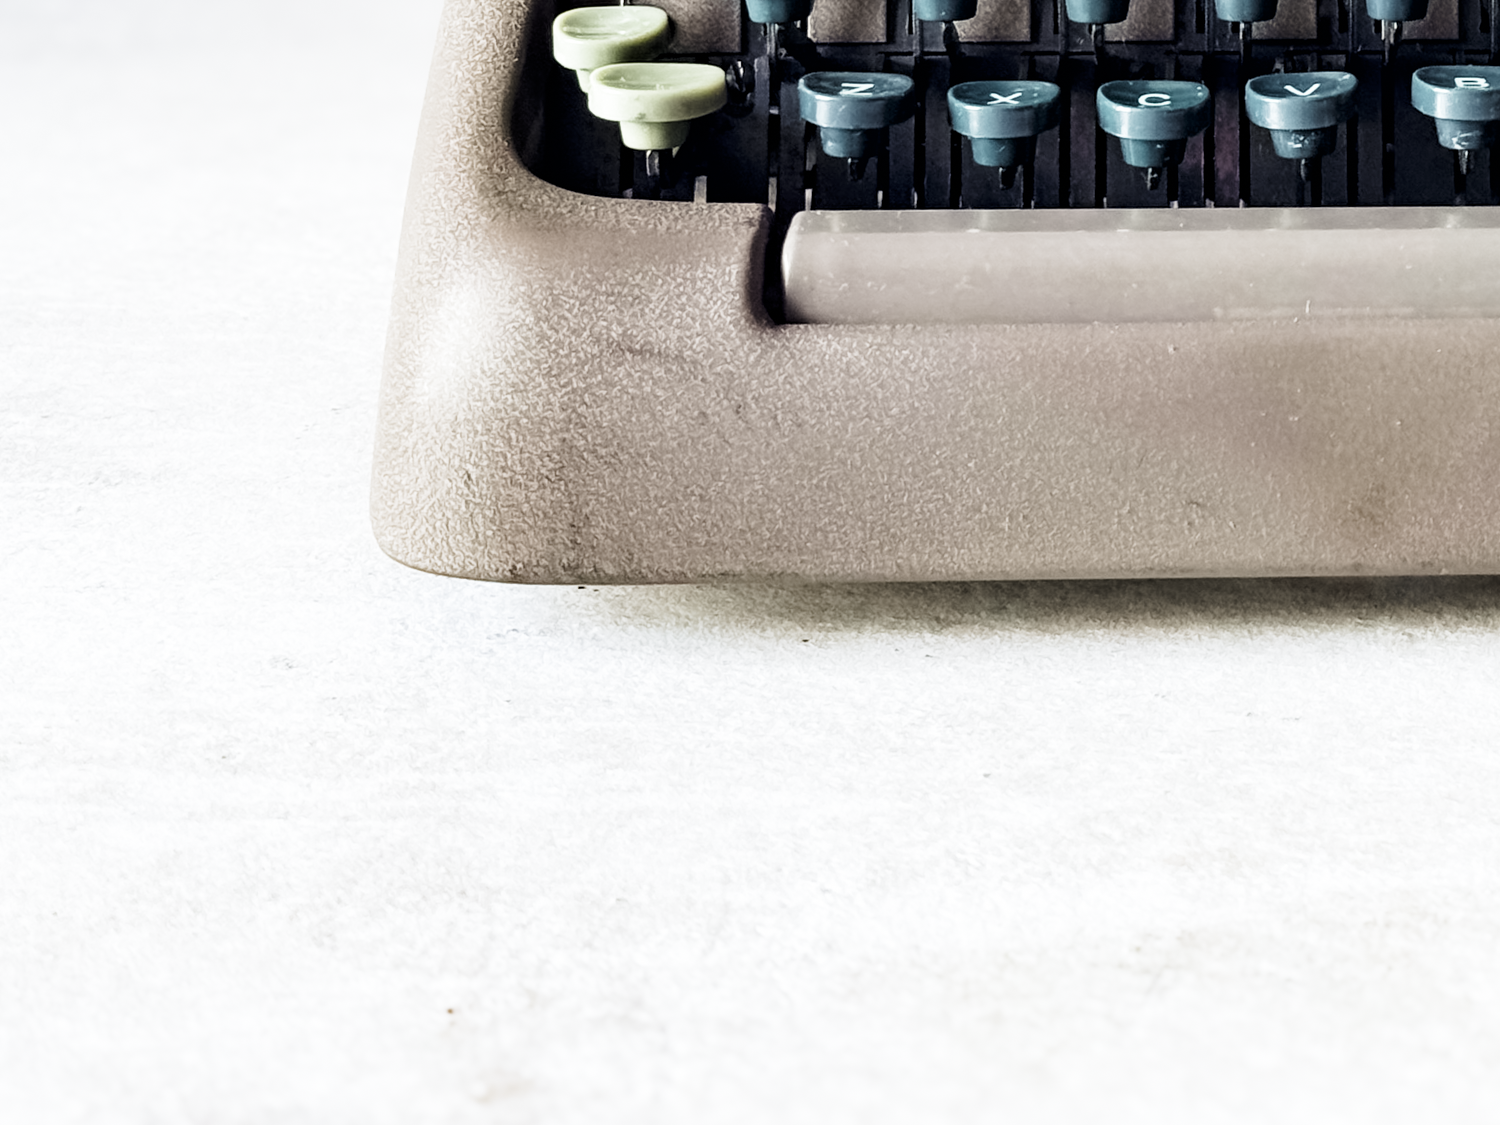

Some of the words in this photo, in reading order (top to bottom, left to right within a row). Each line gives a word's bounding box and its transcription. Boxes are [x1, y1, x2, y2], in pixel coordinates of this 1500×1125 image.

[839, 82, 875, 96] Z
[1283, 82, 1320, 97] V
[1452, 76, 1490, 89] B
[986, 91, 1023, 105] X
[1137, 92, 1172, 107] C
